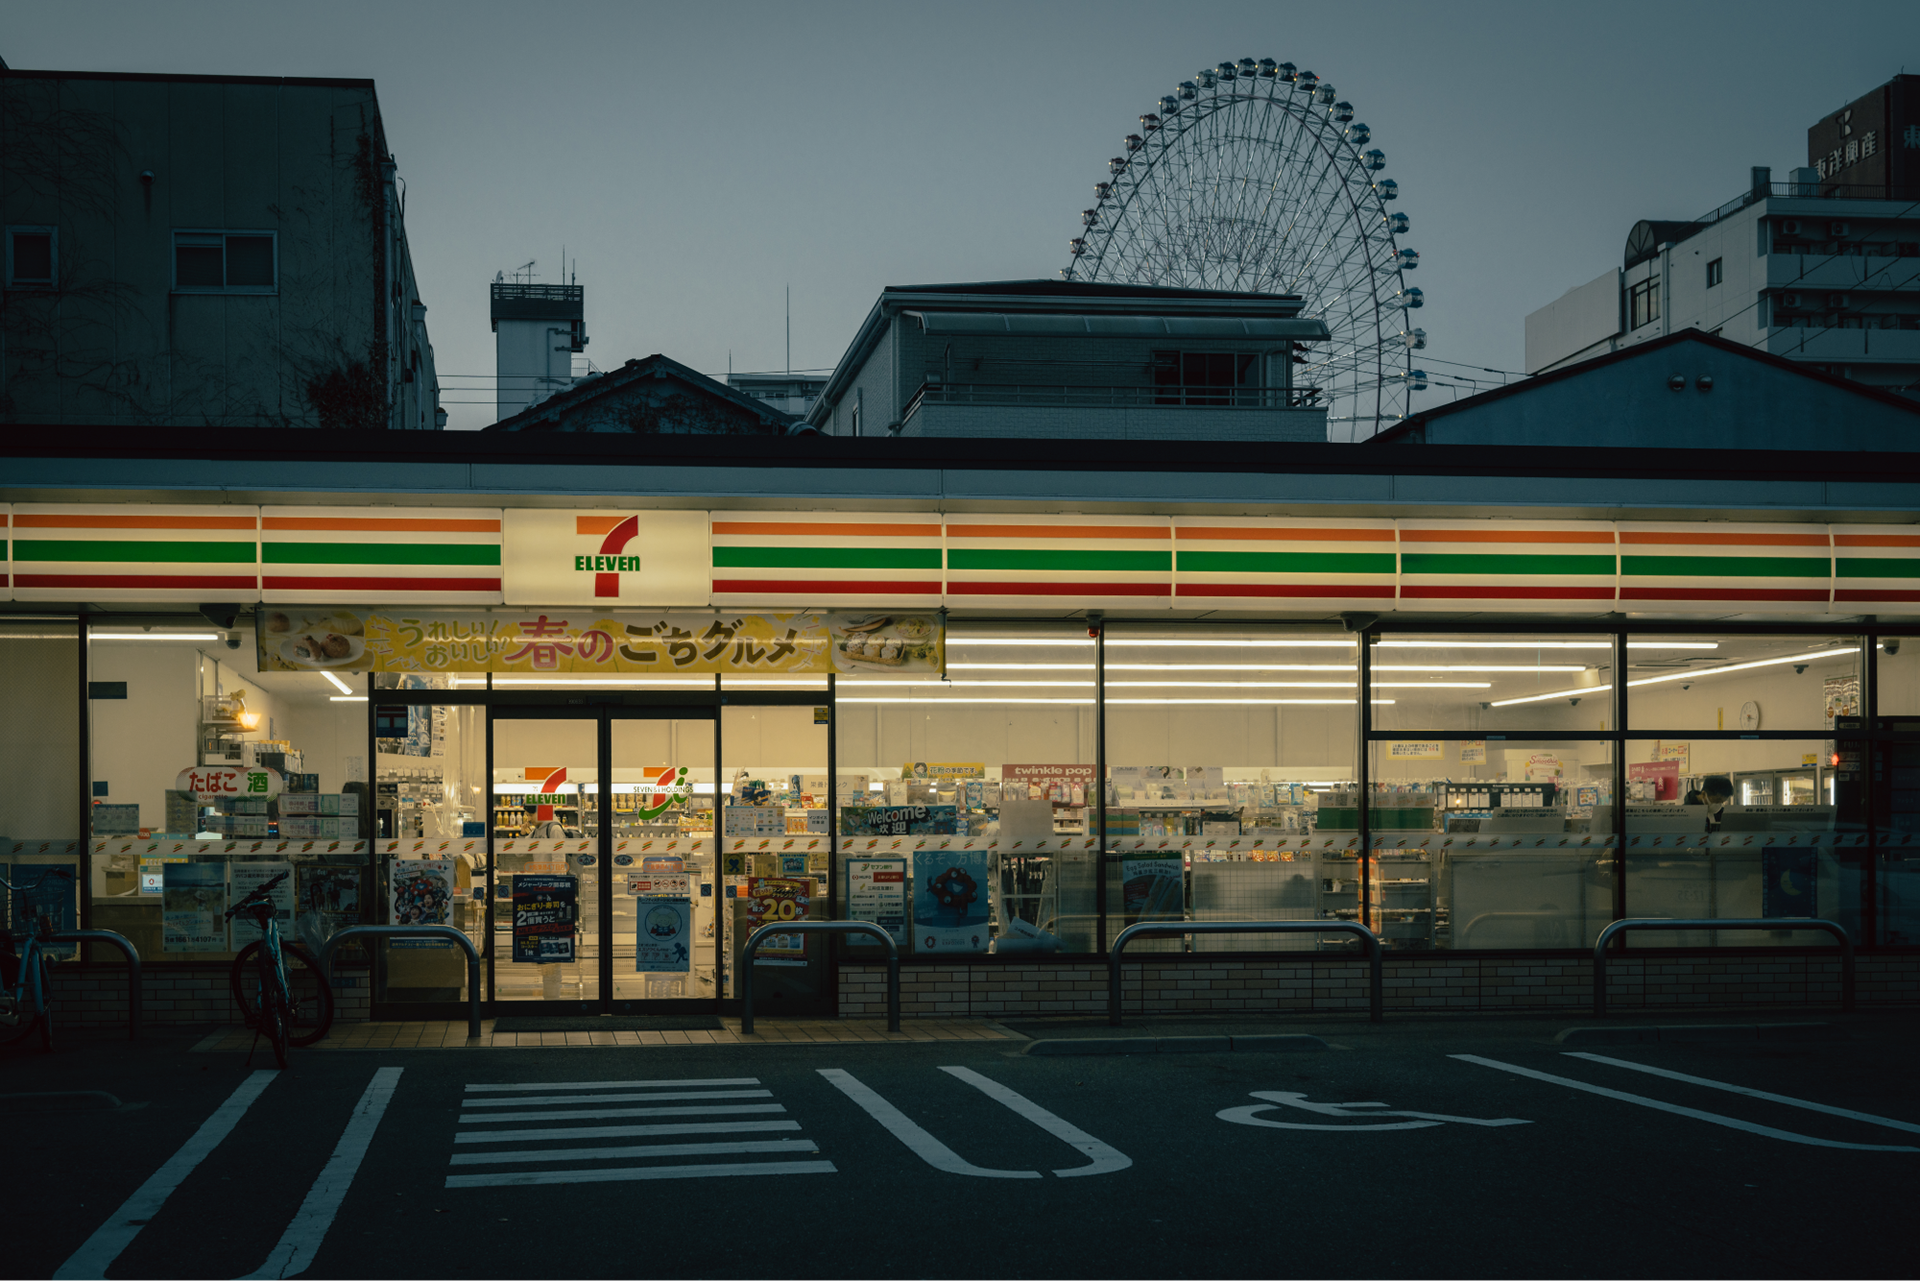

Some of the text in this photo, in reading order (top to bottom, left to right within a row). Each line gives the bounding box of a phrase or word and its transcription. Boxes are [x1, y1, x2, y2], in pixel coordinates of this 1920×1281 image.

[504, 614, 799, 671] 春のごちグルメ
[929, 766, 978, 775] 花粉の季節です。
[1014, 766, 1093, 777] twinkle pop
[189, 771, 268, 793] たばこ 酒
[867, 804, 927, 825] Welcome
[878, 822, 907, 835] 欢迎
[914, 851, 987, 866] くるぞ、万博。
[1154, 861, 1180, 871] Sandwich
